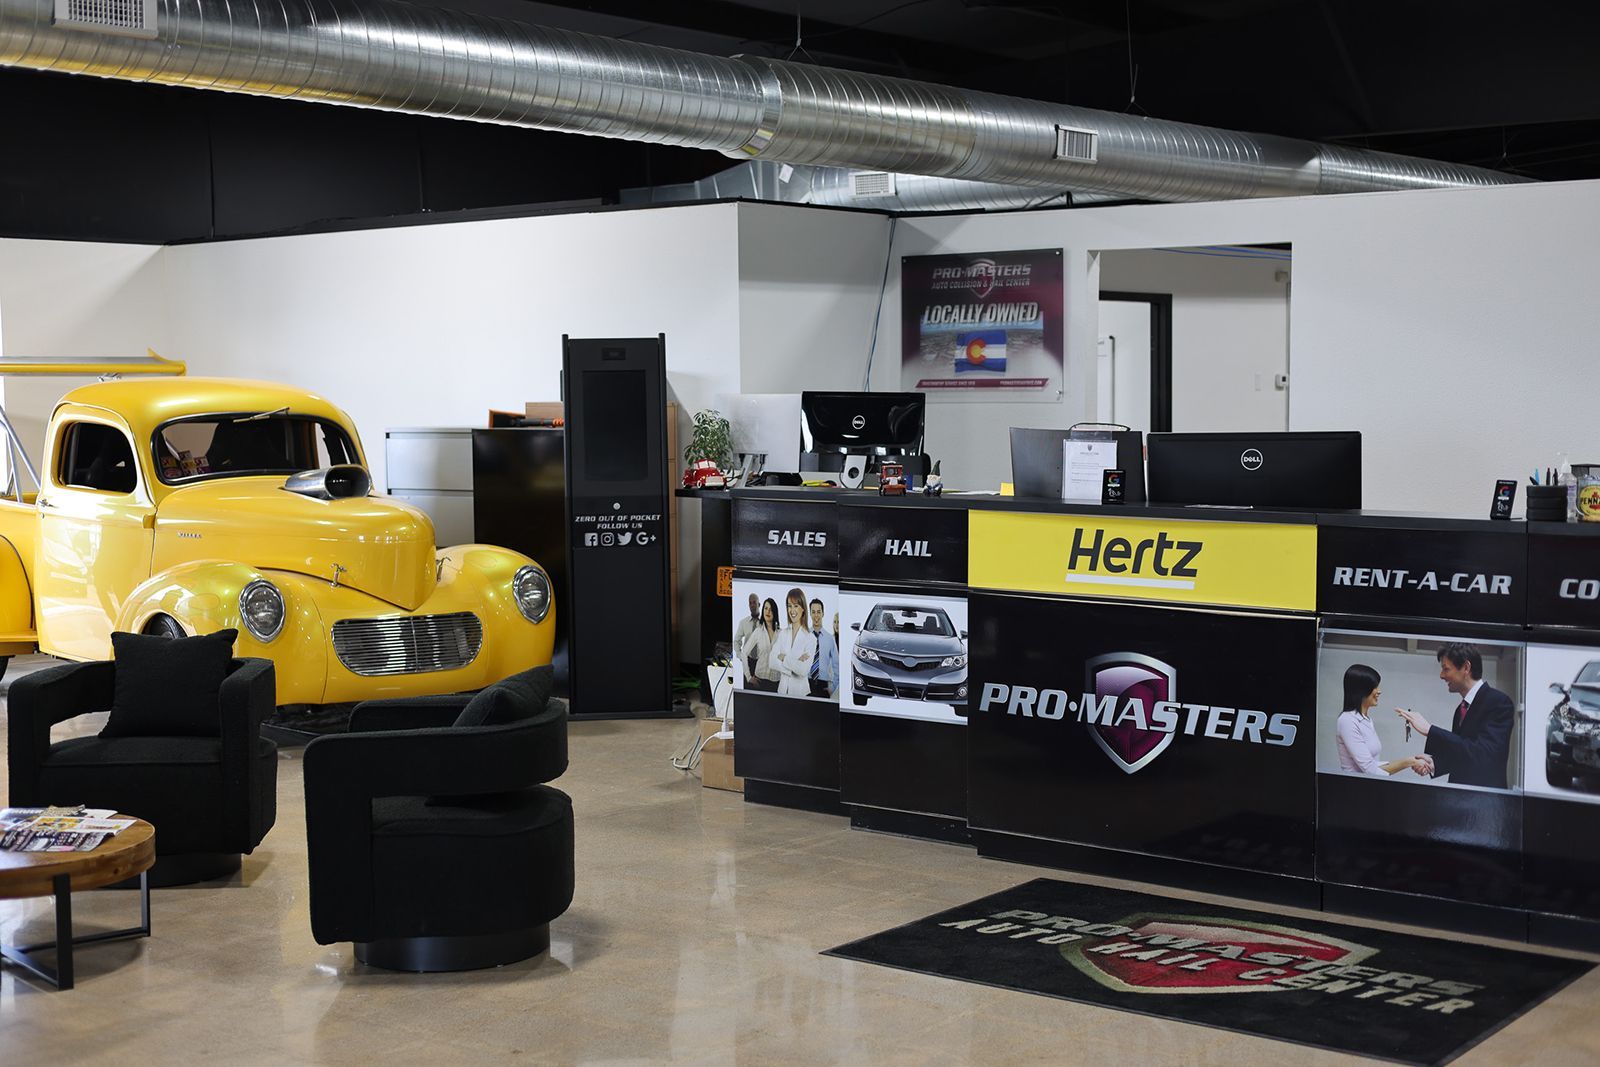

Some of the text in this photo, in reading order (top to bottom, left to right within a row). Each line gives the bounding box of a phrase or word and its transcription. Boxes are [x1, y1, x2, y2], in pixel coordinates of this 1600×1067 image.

[931, 281, 948, 290] AUTO
[949, 280, 982, 289] COLLISION
[1005, 278, 1031, 287] CENTER
[924, 302, 1039, 325] LOCALLY OWNED
[767, 529, 827, 547] SALES
[884, 539, 932, 557] HAIL
[1067, 527, 1204, 578] Hertz
[1332, 566, 1513, 595] RENT-A-CAR
[1559, 578, 1600, 600] CO
[938, 918, 1475, 1014] AUTO HAIL CENTER
